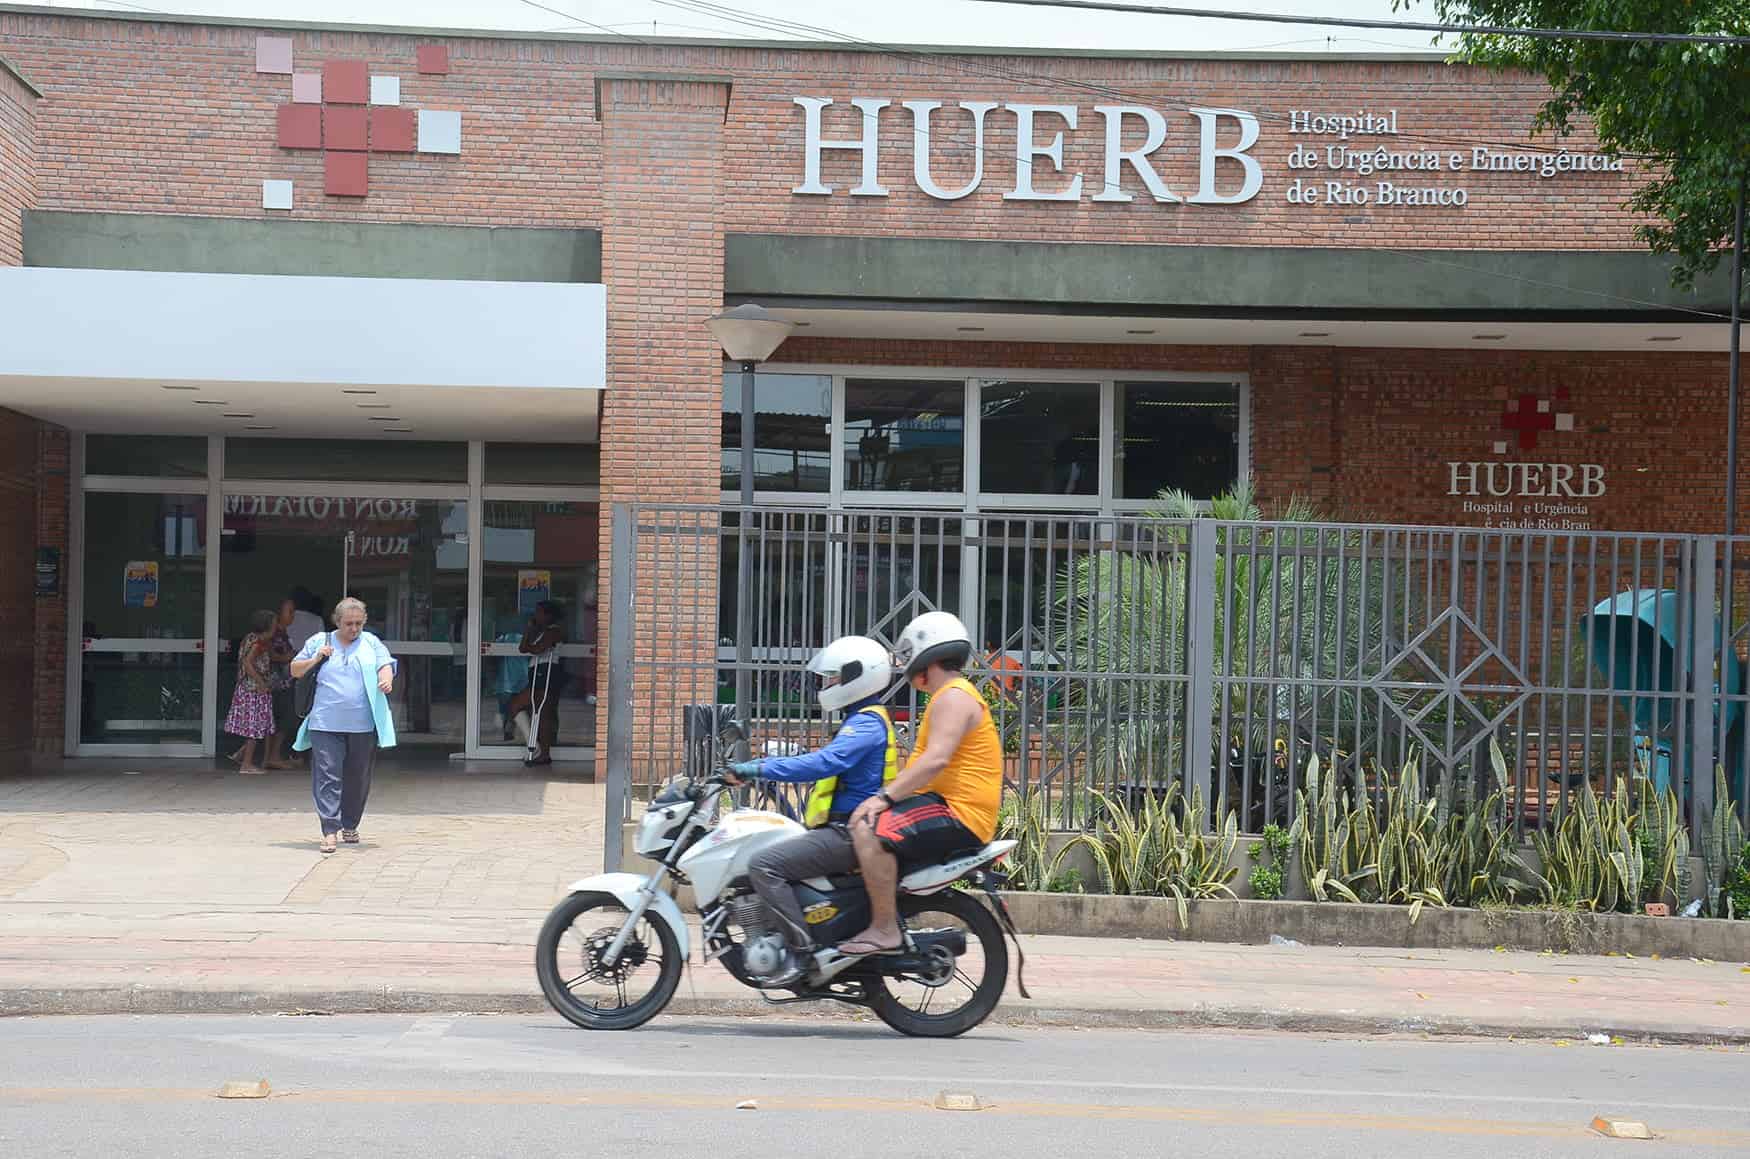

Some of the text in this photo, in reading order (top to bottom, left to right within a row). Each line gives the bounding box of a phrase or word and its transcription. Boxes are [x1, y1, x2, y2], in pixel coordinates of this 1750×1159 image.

[1288, 109, 1398, 140] Hospital
[791, 97, 1264, 204] HUERB
[1288, 144, 1318, 169] de
[1326, 145, 1441, 176] Urgência
[1449, 151, 1464, 170] e
[1286, 179, 1468, 206] de Rio Branco
[1447, 462, 1606, 497] HUERB
[1463, 501, 1513, 515] Hospital
[1534, 502, 1589, 516] Urgência
[1538, 518, 1559, 530] Rio
